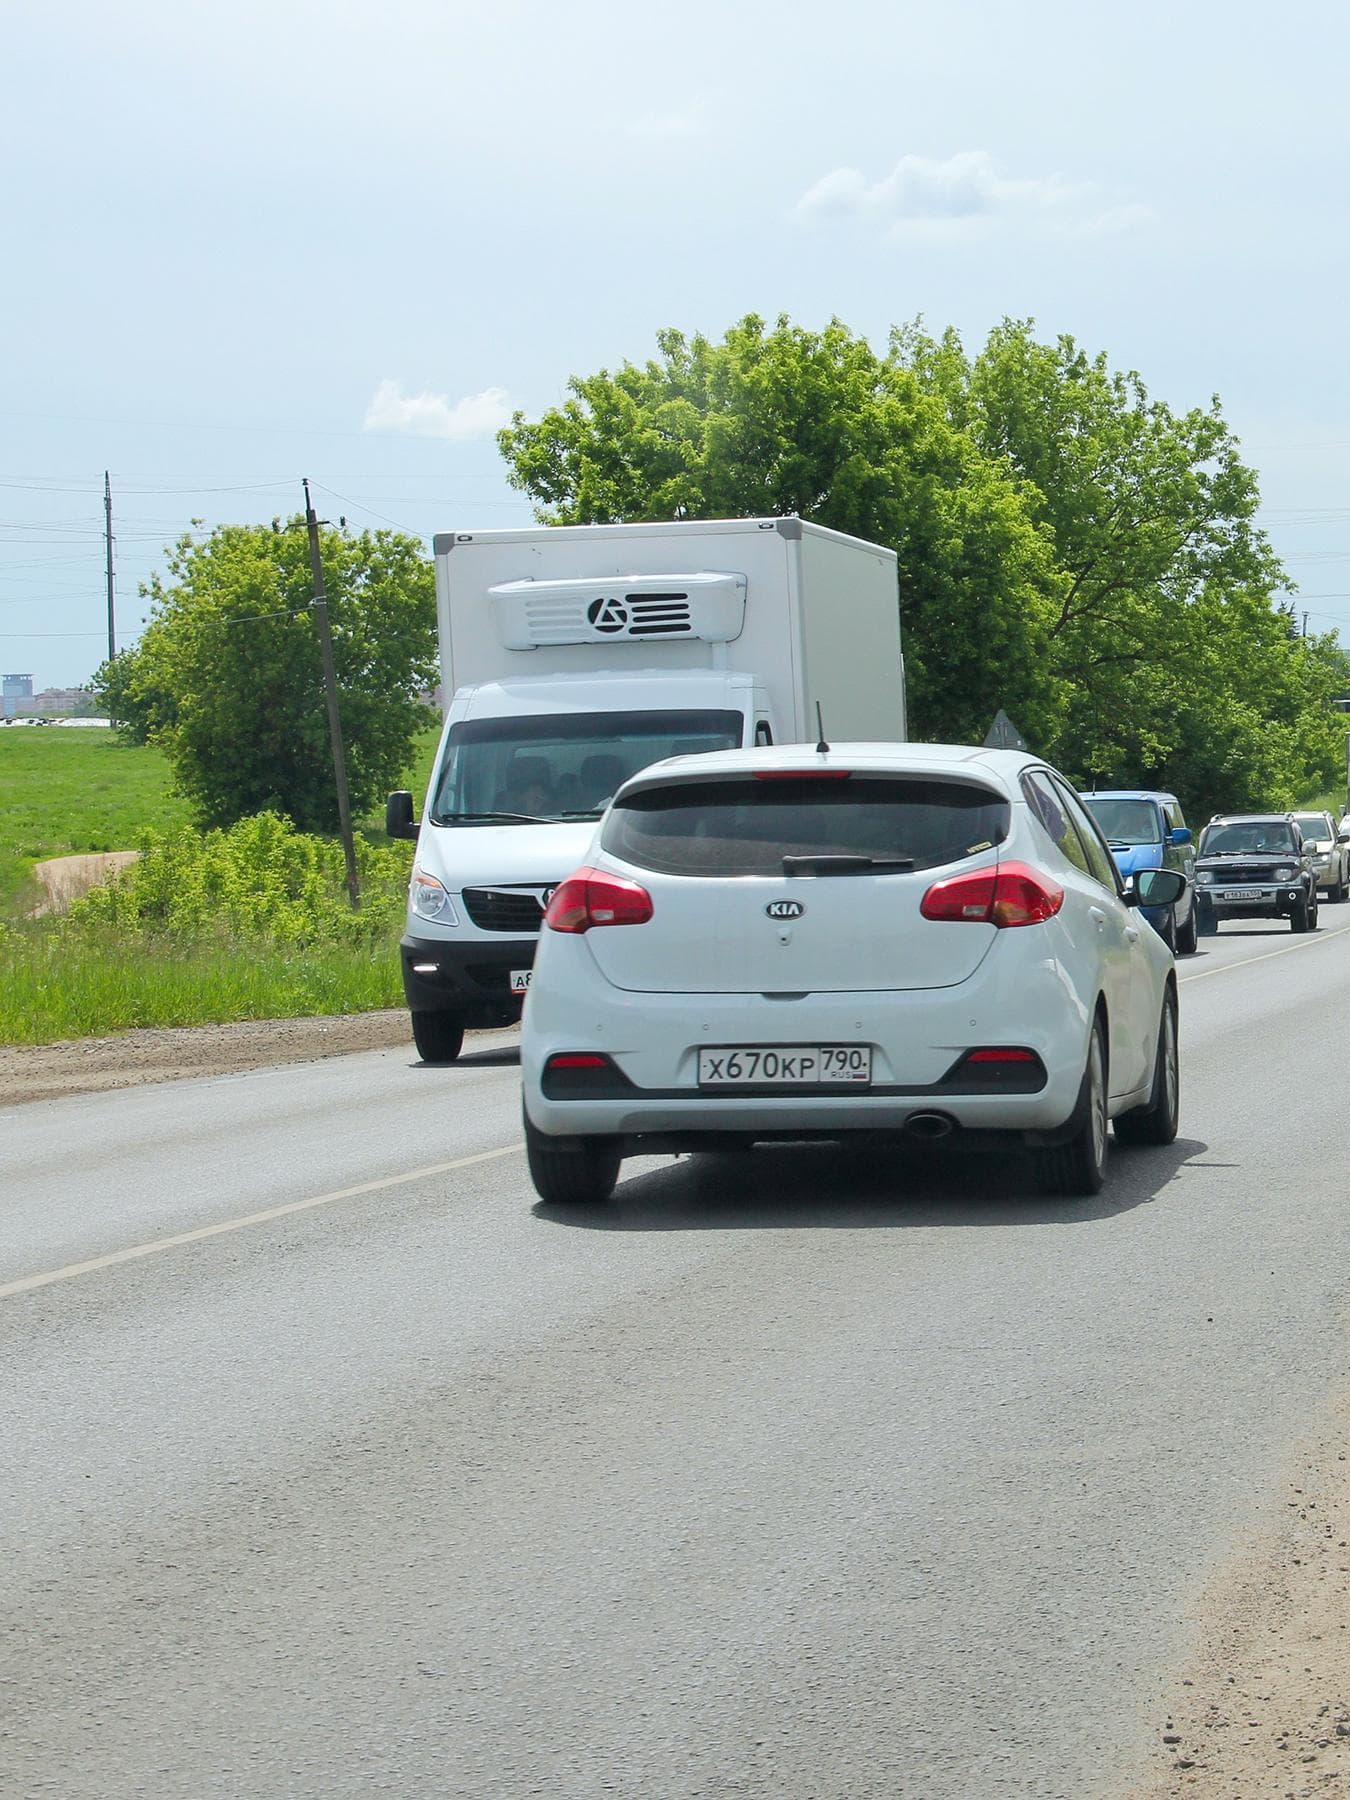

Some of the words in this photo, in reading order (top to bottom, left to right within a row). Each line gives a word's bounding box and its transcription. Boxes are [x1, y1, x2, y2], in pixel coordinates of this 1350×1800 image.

[769, 903, 800, 916] KIA
[708, 1052, 815, 1080] Х670КР
[821, 1049, 863, 1071] 790
[830, 1071, 852, 1079] RUS
